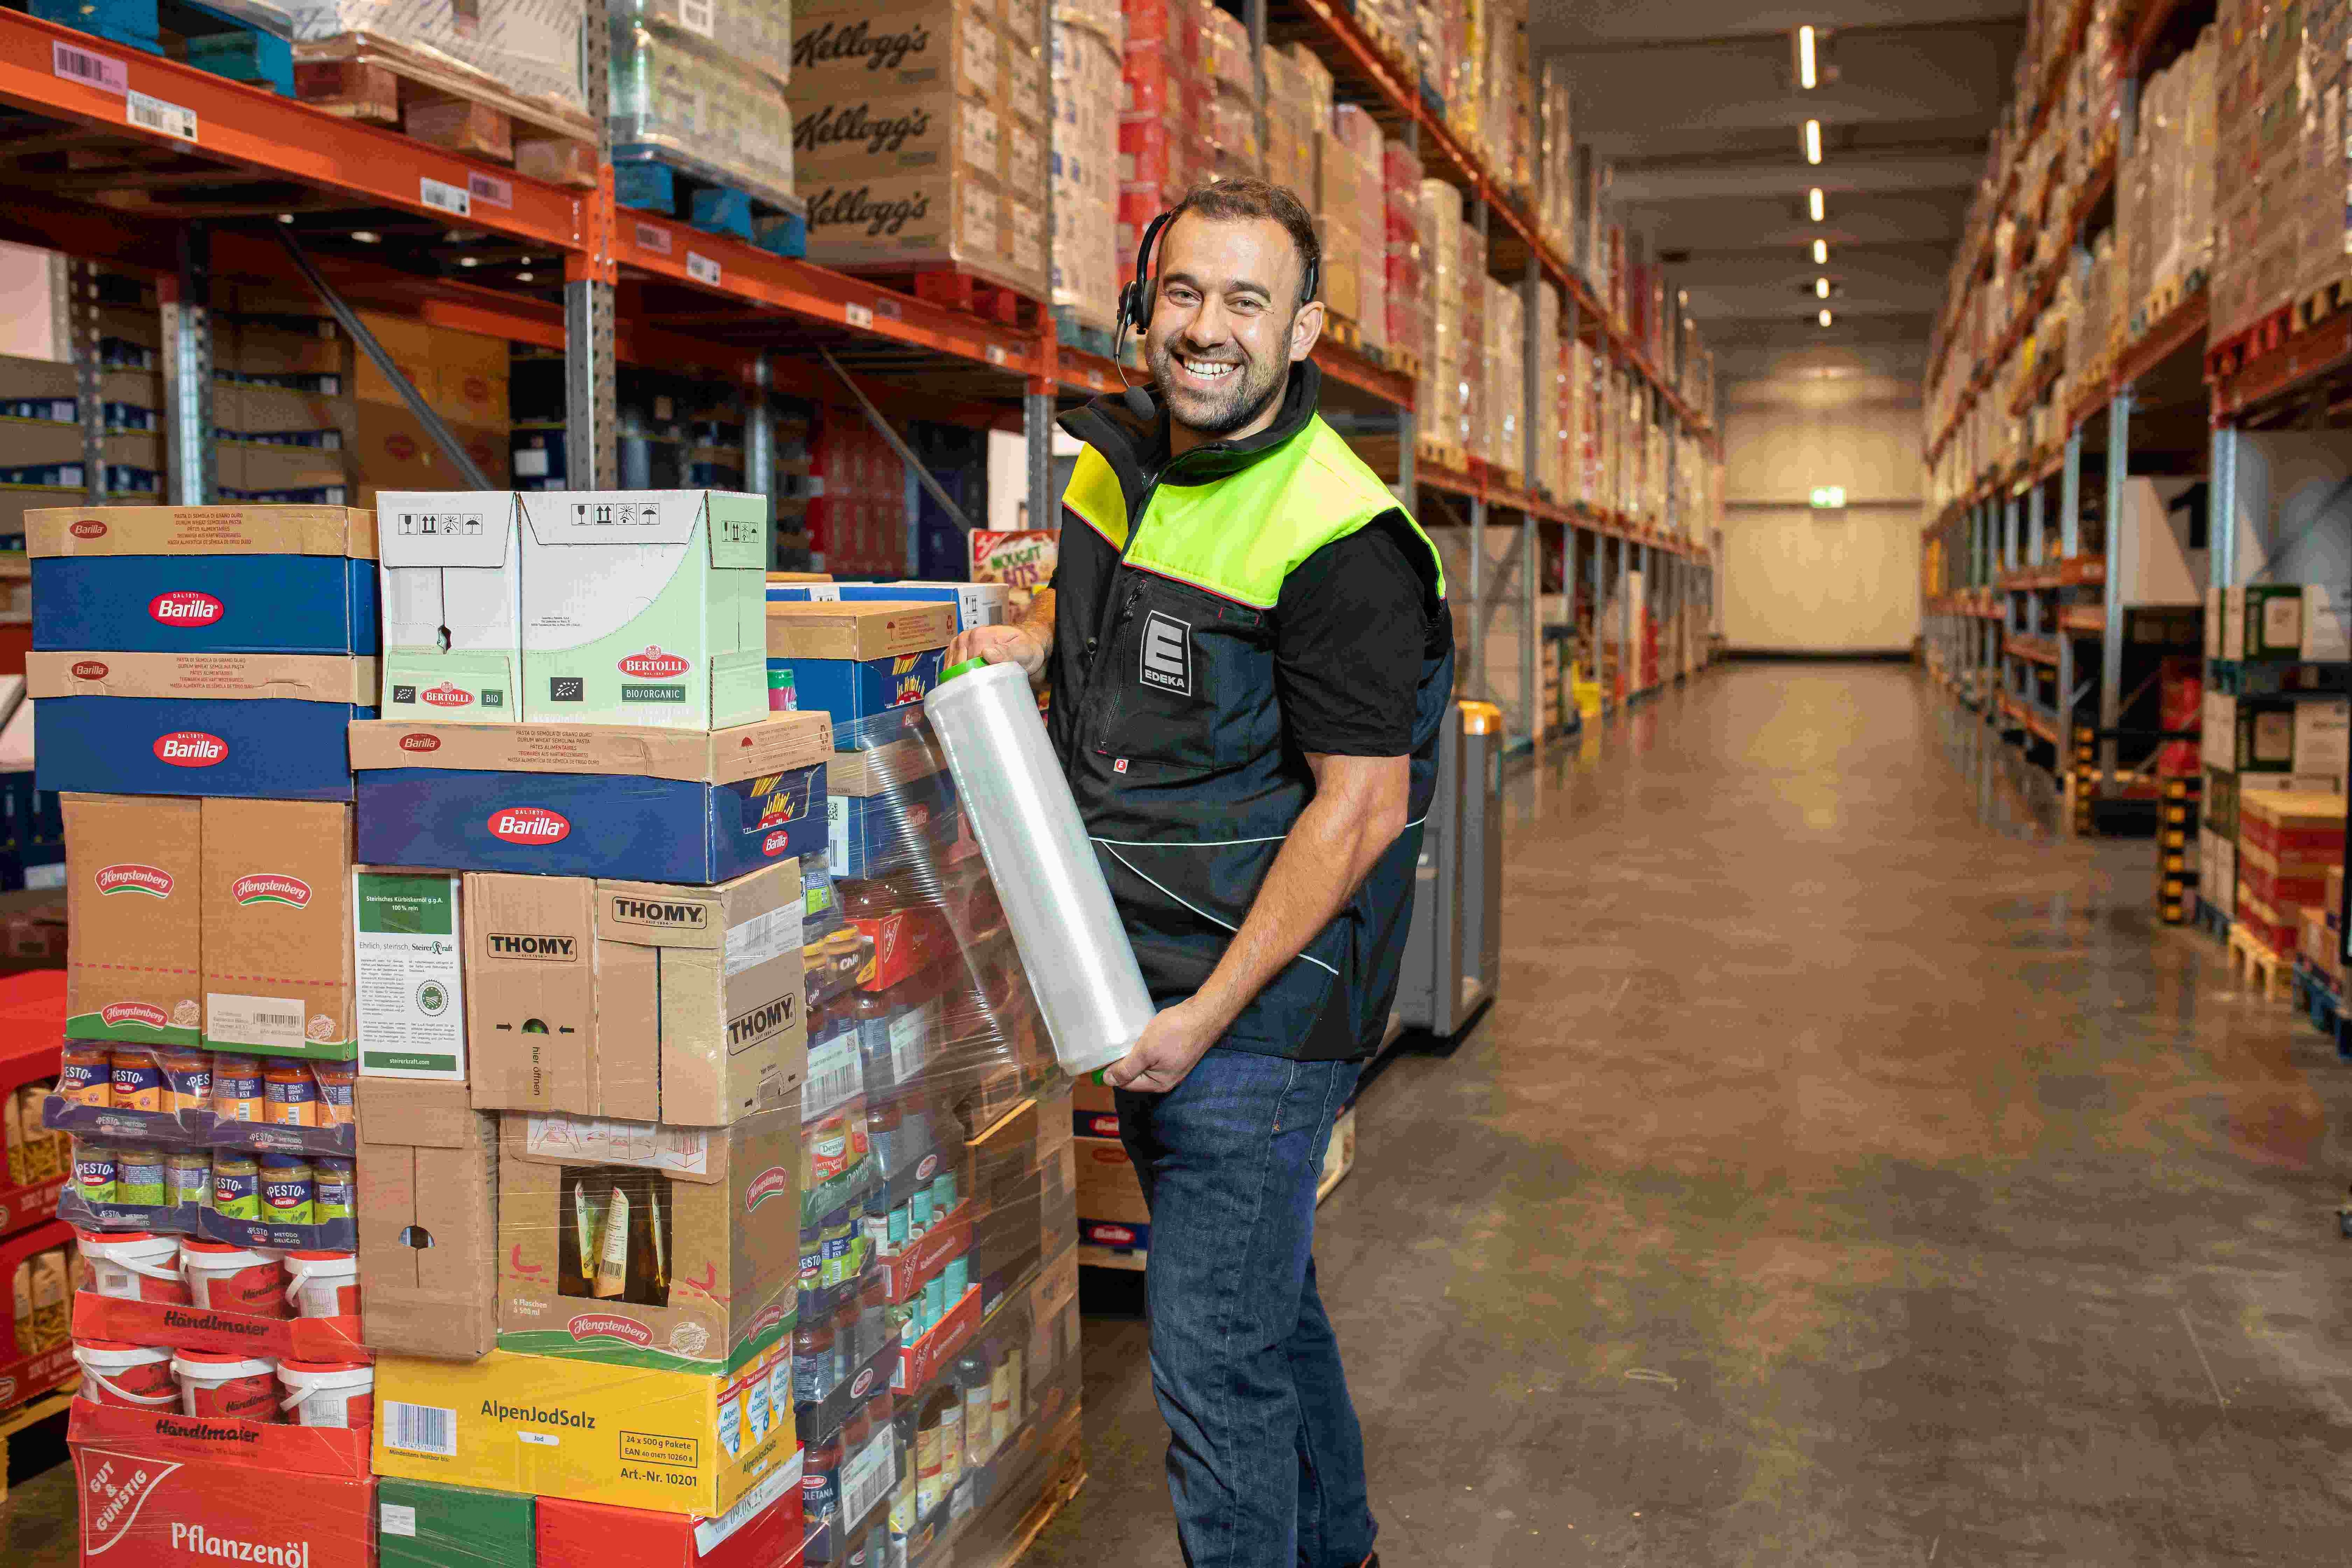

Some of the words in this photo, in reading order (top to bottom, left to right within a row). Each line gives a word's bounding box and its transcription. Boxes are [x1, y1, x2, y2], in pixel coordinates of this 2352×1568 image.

[791, 18, 931, 70] Kellogg's
[793, 100, 932, 153] Kellogg's
[75, 525, 103, 534] Barilla
[159, 600, 214, 617] Barilla
[76, 666, 105, 675] Barilla
[626, 661, 683, 671] BERTOLLI
[1144, 669, 1185, 688] EDEKA
[426, 692, 469, 702] BERTOLLI
[626, 690, 680, 699] BIO/ORGANIC
[163, 740, 218, 758] Barilla
[405, 738, 436, 748] Barilla
[499, 816, 559, 836] Barilla
[766, 835, 786, 851] Barilla
[101, 870, 168, 889] Hengstenberg
[237, 881, 306, 899] Hengstenberg
[616, 899, 702, 922] THOMY
[490, 936, 572, 955] THOMY
[809, 989, 819, 1004] Chio
[106, 1006, 164, 1023] Hengstenberg
[729, 996, 792, 1045] THOMY
[532, 1047, 540, 1061] hier
[112, 1070, 139, 1083] PESTO
[532, 1063, 540, 1096] öffnen
[78, 1162, 110, 1175] PESTO
[269, 1184, 301, 1196] PESTO
[749, 1175, 784, 1203] Hengstenberg
[248, 1227, 267, 1236] PESTO
[519, 1299, 547, 1308] Flaschen
[164, 1310, 269, 1336] Händlmaier
[574, 1318, 648, 1341] Hengstenberg
[755, 1386, 767, 1399] Alpen
[481, 1400, 596, 1430] AlpenJodSalz
[723, 1406, 737, 1421] Alpen
[156, 1419, 259, 1442] Händlmaier
[389, 1449, 419, 1458] Mindestens
[666, 1441, 691, 1449] Pakete
[742, 1440, 776, 1474] AlpenJodSalz
[88, 1460, 115, 1493] GUT
[620, 1468, 662, 1482] Art.-Nr.
[666, 1473, 697, 1486] 10201
[106, 1483, 118, 1496] &
[96, 1470, 148, 1532] GÜNSTIG
[171, 1522, 309, 1568] Pflanzenöl
